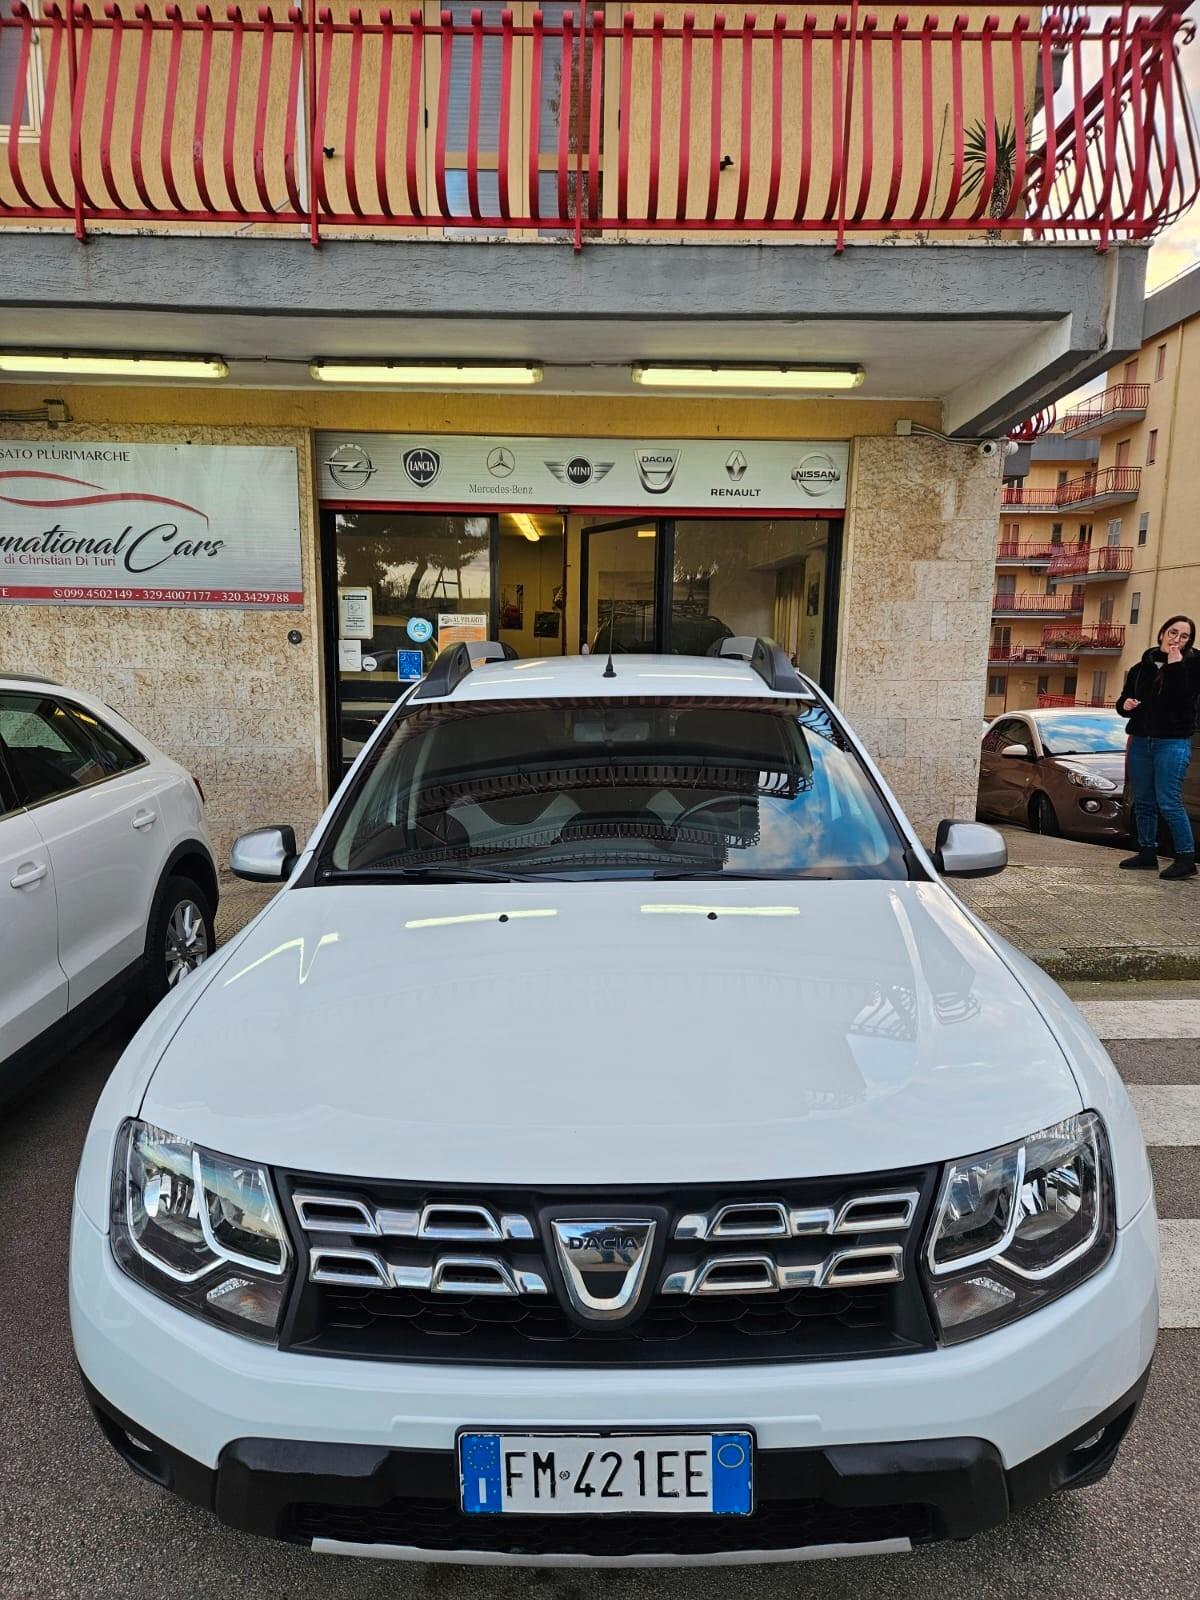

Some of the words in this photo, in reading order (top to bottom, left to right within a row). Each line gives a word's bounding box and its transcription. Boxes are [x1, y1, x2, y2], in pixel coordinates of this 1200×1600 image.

[37, 449, 131, 462] PLURIMARCHE
[641, 455, 674, 464] DACIA
[409, 460, 435, 472] LANCIA
[568, 466, 591, 477] MINI
[795, 469, 837, 479] NISSAN
[469, 484, 533, 495] Mercedes-Benz
[710, 488, 762, 497] RENAULT
[124, 523, 226, 574] Cars
[4, 553, 15, 564] di
[18, 554, 71, 566] Christian
[75, 555, 88, 567] Di
[92, 555, 116, 567] Turi
[63, 588, 132, 599] 099.4502149
[143, 590, 211, 601] 329.4007177
[221, 592, 289, 603] 320.3429788
[569, 1236, 639, 1250] DACIA
[504, 1450, 556, 1499] FM
[573, 1450, 708, 1498] 421EE
